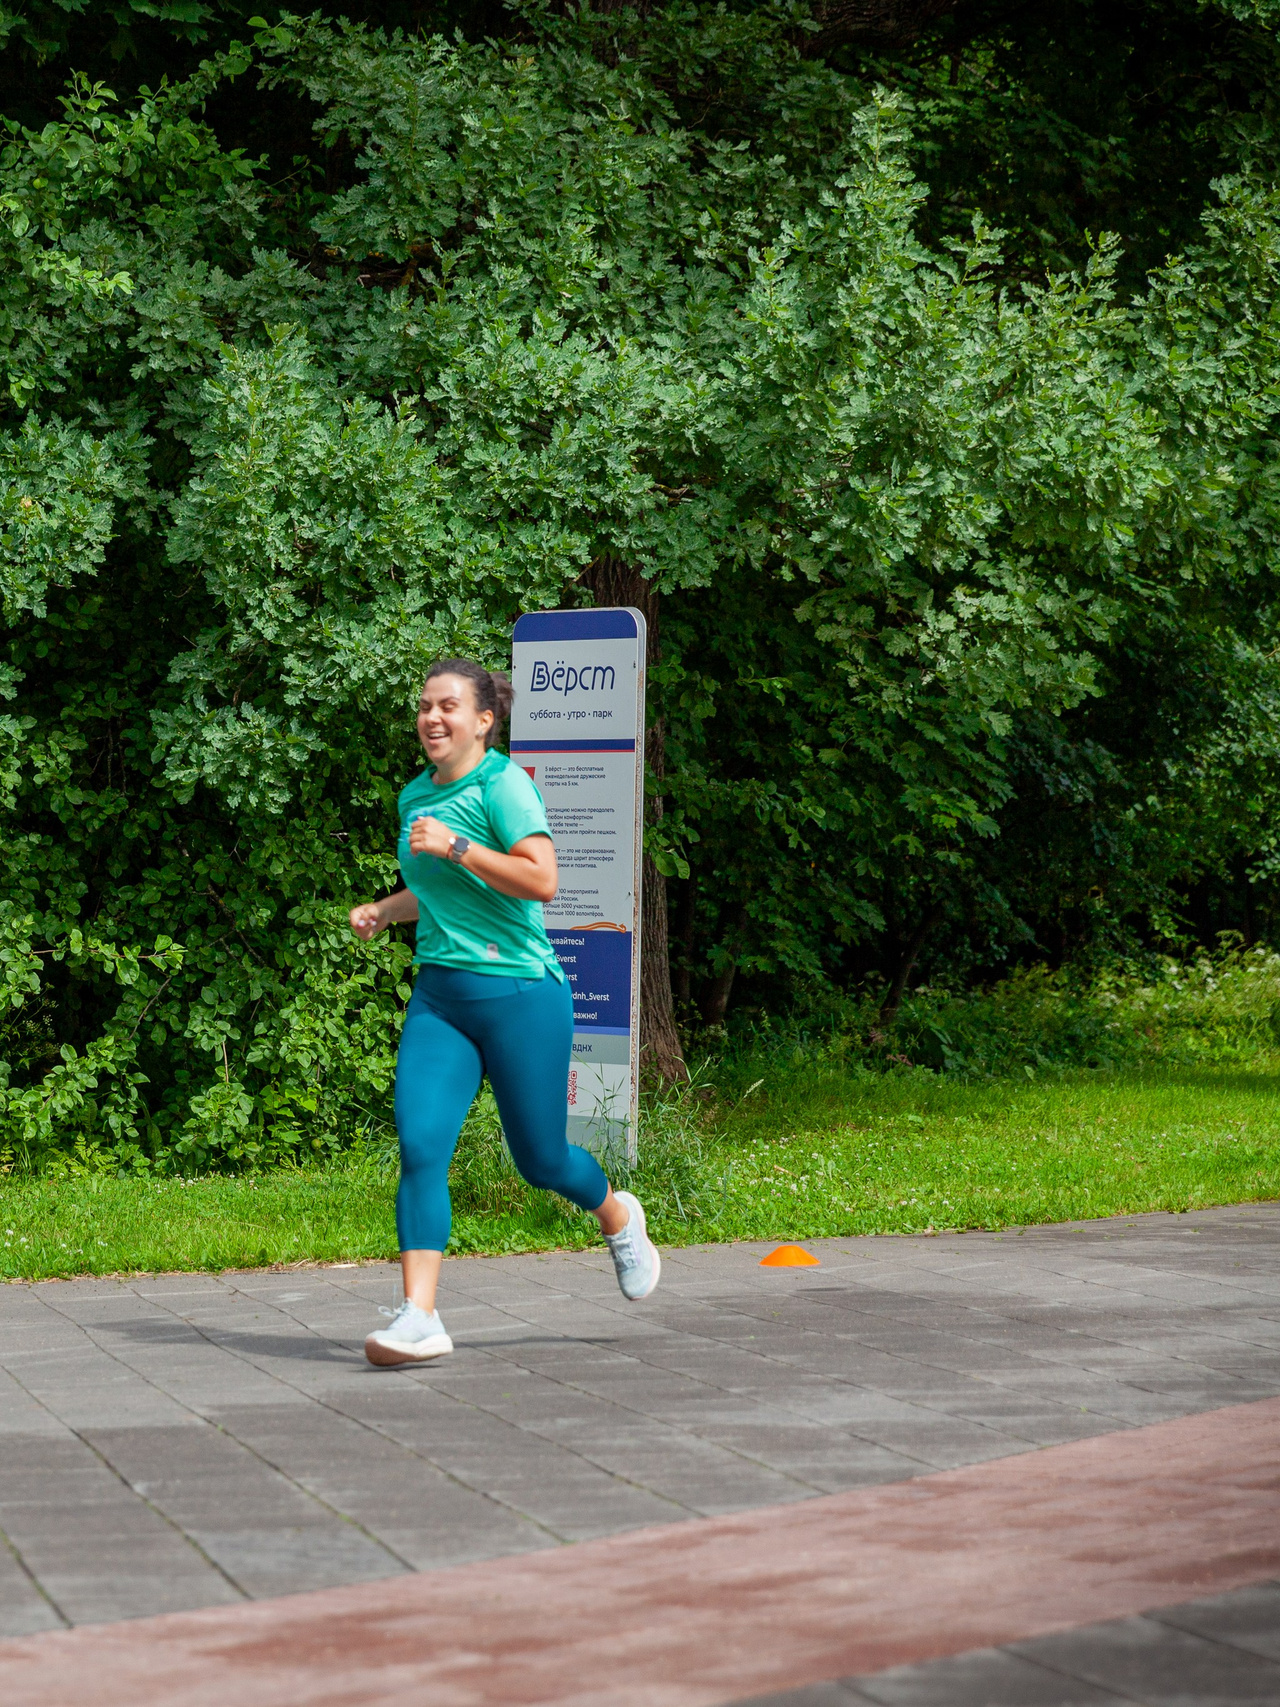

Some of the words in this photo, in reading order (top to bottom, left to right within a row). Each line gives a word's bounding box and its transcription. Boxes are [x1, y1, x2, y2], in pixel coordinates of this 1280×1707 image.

[529, 709, 561, 721] суббота
[567, 710, 587, 720] утро
[592, 709, 613, 719] парк
[548, 937, 585, 945] сывайтесь!
[573, 1012, 597, 1020] важно!
[572, 1044, 593, 1052] ВДНХ
